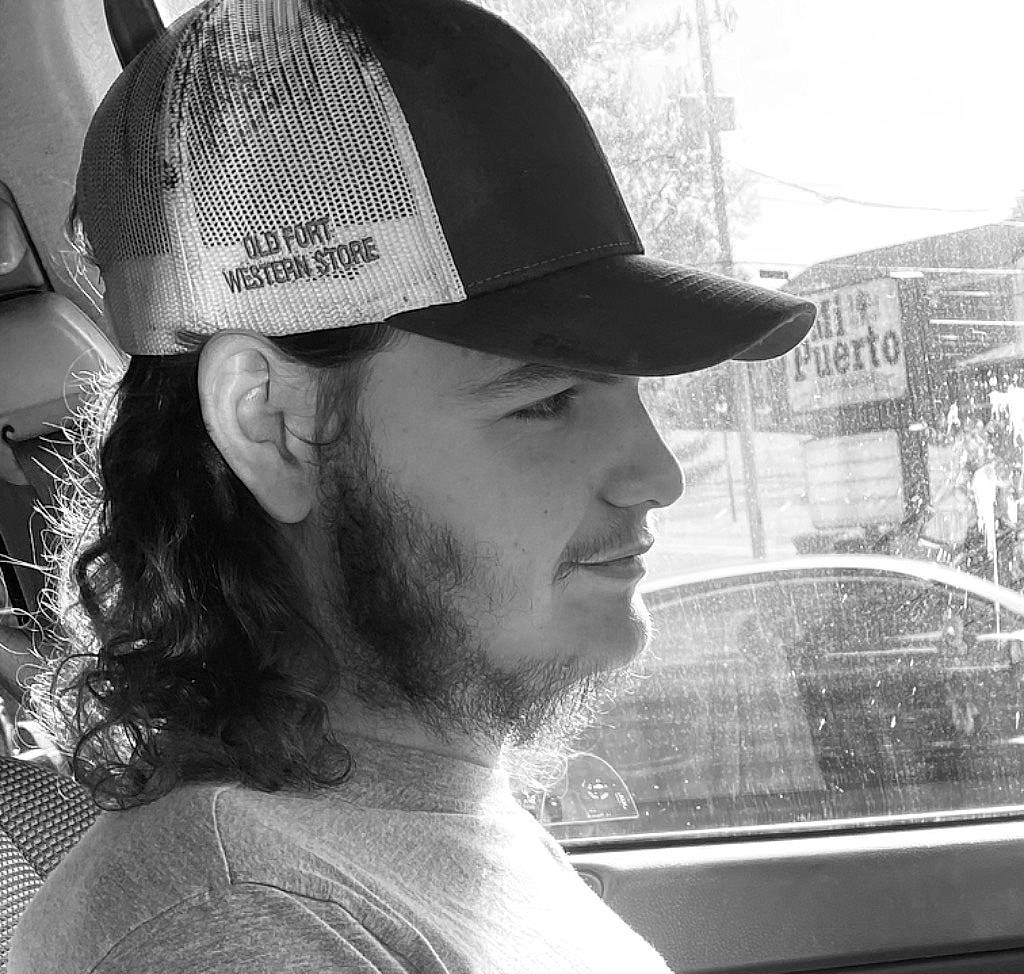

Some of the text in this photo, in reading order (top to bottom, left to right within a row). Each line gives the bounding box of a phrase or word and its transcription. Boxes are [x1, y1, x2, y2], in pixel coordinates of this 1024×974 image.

[222, 236, 380, 294] WESTERN STORE
[243, 217, 331, 260] OLD FORT
[794, 325, 900, 382] Puerto
